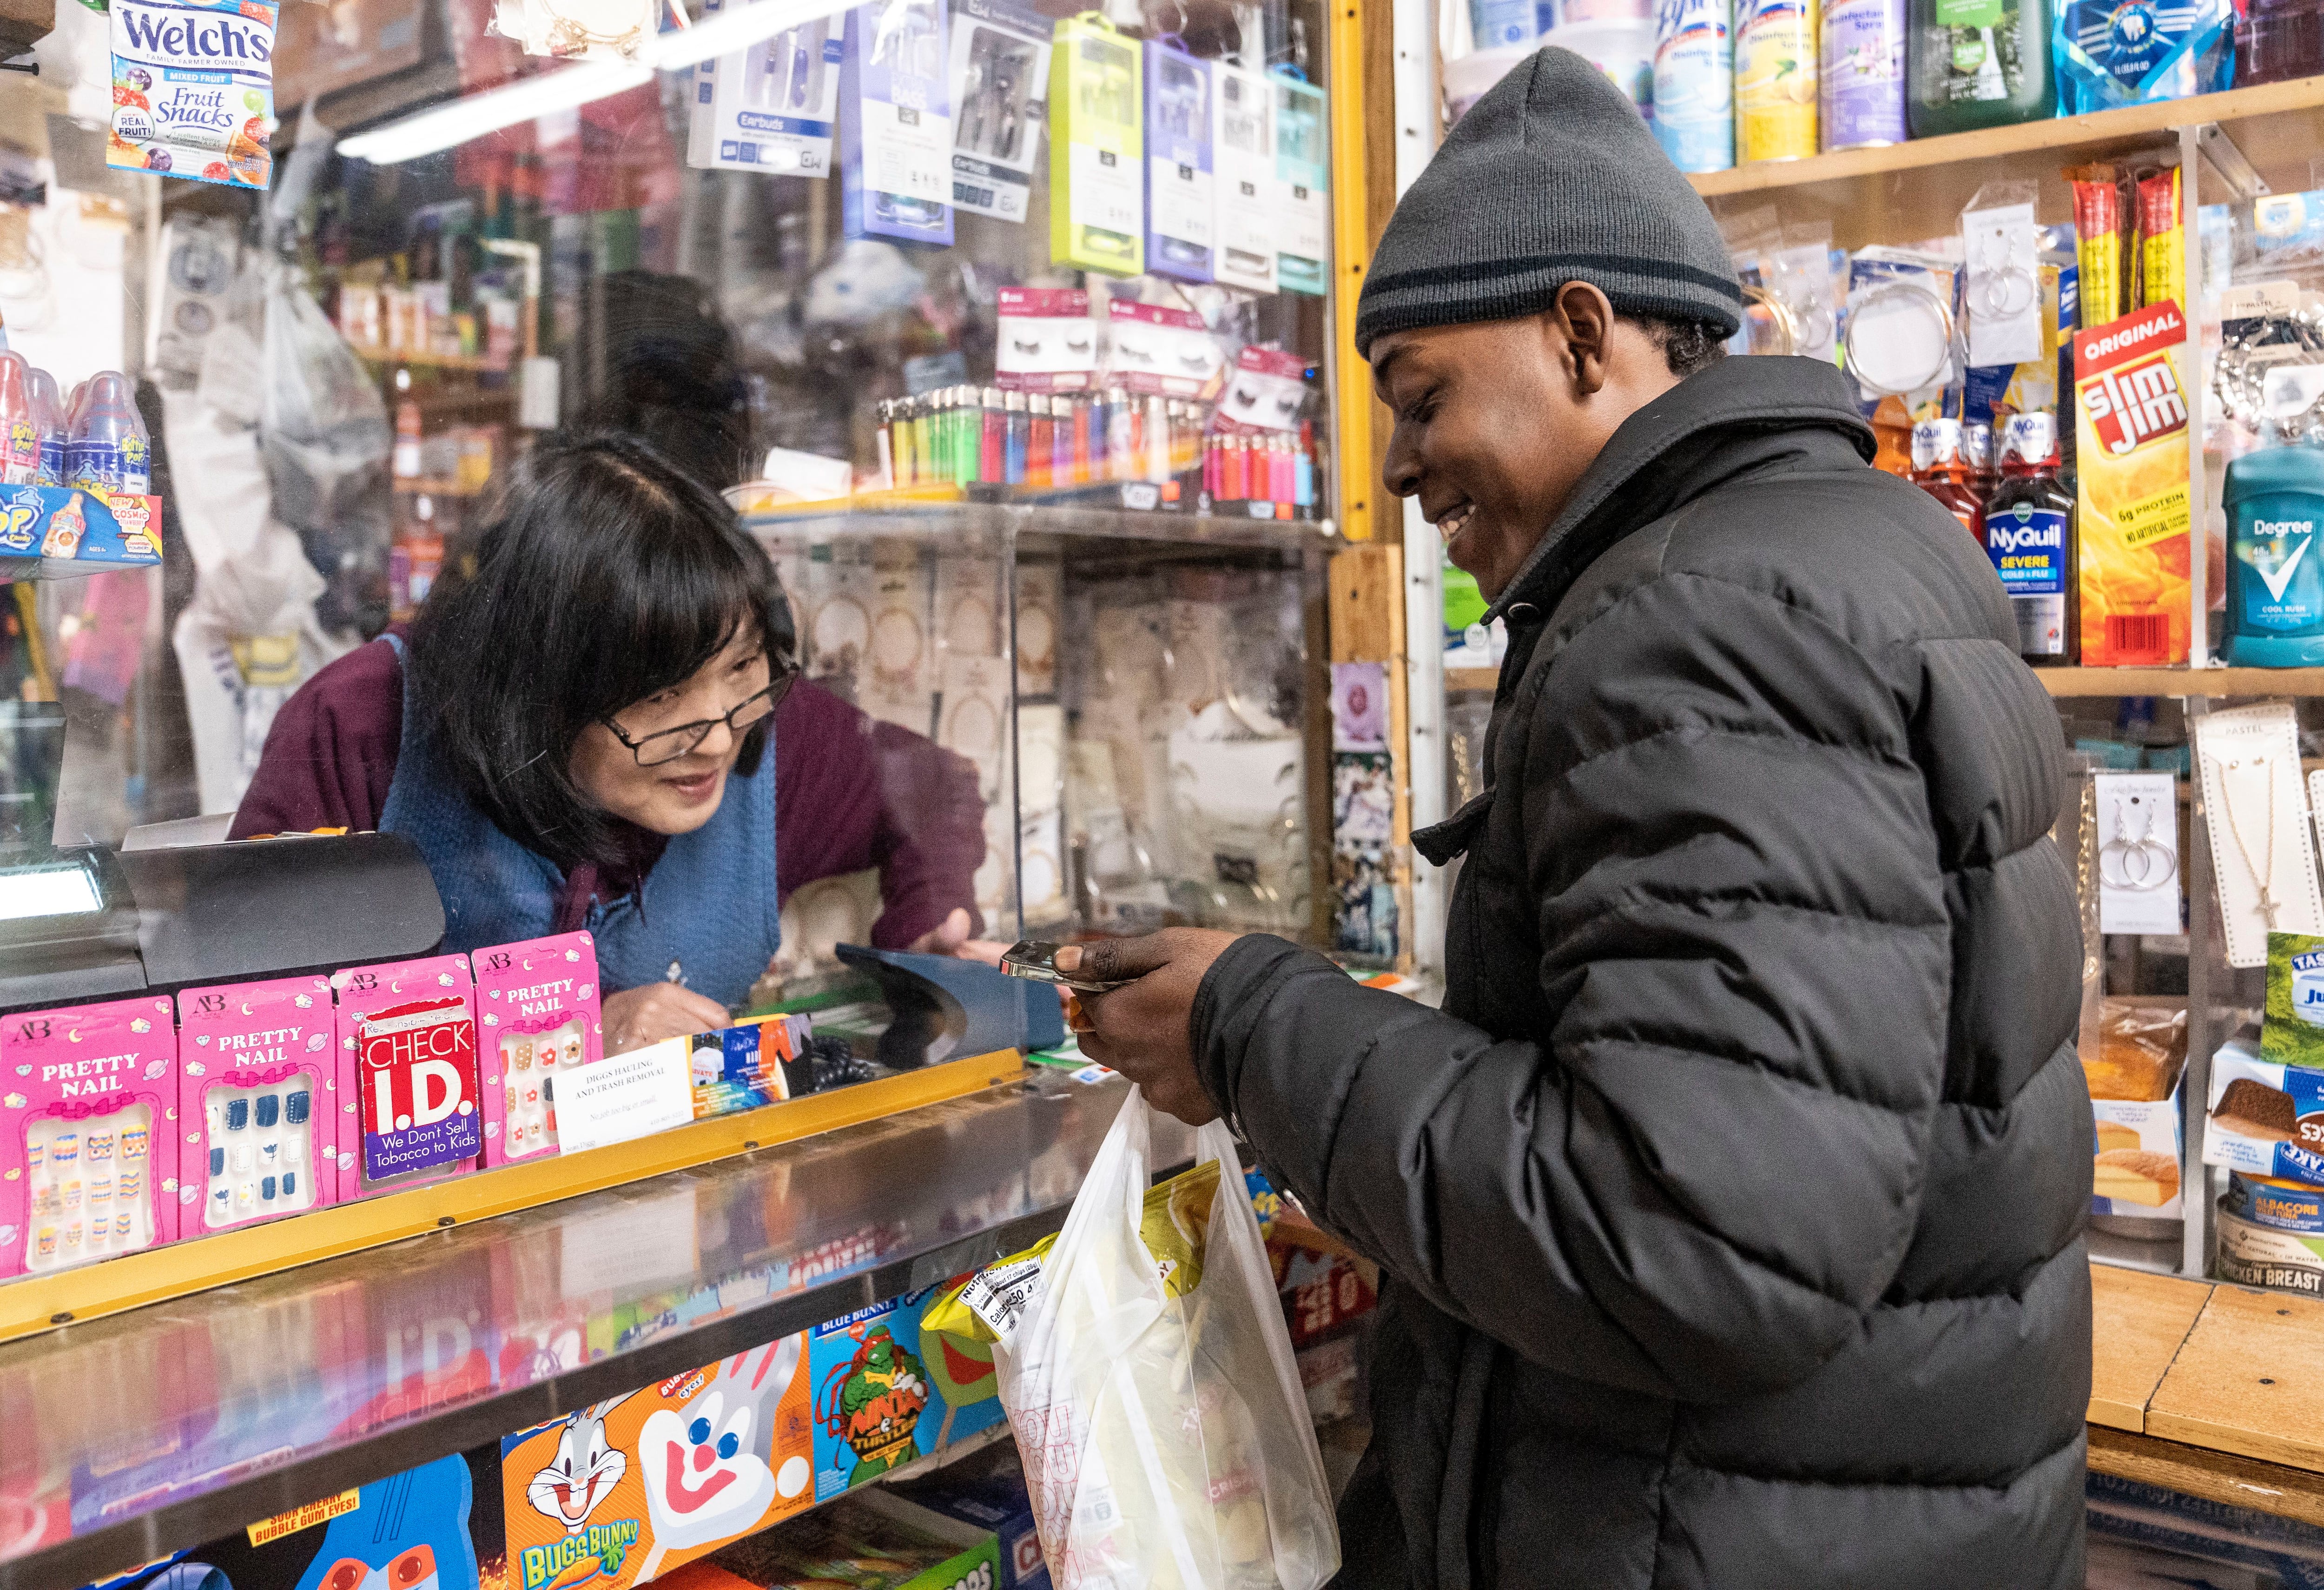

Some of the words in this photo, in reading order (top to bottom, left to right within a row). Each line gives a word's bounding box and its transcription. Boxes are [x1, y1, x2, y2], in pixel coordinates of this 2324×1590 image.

[117, 7, 271, 62] Welch's
[146, 54, 174, 63] FAMILY
[170, 73, 198, 82] MIXED
[200, 73, 226, 83] FRUIT
[172, 87, 225, 107] Fruit
[121, 117, 146, 126] REAL
[156, 101, 234, 128] Snacks
[741, 114, 784, 131] Earbuds
[118, 127, 151, 136] FRUIT!
[2084, 312, 2179, 360] ORIGINAL
[110, 497, 132, 506] NEW
[2119, 510, 2134, 523] 6g
[2136, 493, 2185, 515] PROTEIN
[113, 510, 148, 520] COSMIC
[1989, 524, 2061, 553] NyQuil
[2125, 531, 2136, 544] NO
[2137, 520, 2169, 540] ARTIFICIAL
[2254, 519, 2313, 538] Degree
[2000, 555, 2050, 569] SEVERE
[2001, 570, 2025, 580] COLD
[2225, 725, 2264, 736] PASTEL
[507, 978, 574, 1004] PRETTY
[521, 998, 563, 1017] NAIL
[218, 1026, 304, 1052] PRETTY
[366, 1022, 471, 1069] CHECK
[42, 1053, 141, 1081] PRETTY
[235, 1047, 288, 1067] NAIL
[575, 1088, 594, 1100] AND
[595, 1079, 625, 1093] TRASH
[626, 1067, 667, 1084] REMOVAL
[586, 1070, 614, 1085] DIGGS
[615, 1059, 654, 1076] HAULING
[61, 1075, 124, 1099] NAIL
[374, 1060, 474, 1136] I.D.
[381, 1133, 404, 1150] We
[407, 1124, 442, 1147] Don't
[445, 1117, 468, 1134] Sell
[375, 1145, 430, 1168] Tobacco
[433, 1140, 446, 1153] to
[449, 1134, 477, 1149] Kids
[2256, 1197, 2319, 1215] ALBACORE
[1013, 1269, 1026, 1279] chips
[1025, 1261, 1038, 1272] (28g)
[2265, 1269, 2321, 1292] BREAST
[822, 1315, 851, 1332] BLUE
[679, 1374, 705, 1399] eyes!
[847, 1387, 924, 1443] NINJA
[255, 1520, 297, 1543] BUBBLE
[300, 1509, 325, 1526] GUM
[328, 1497, 357, 1517] EYES!
[523, 1538, 588, 1587] BUGS
[589, 1521, 639, 1555] BUNNY
